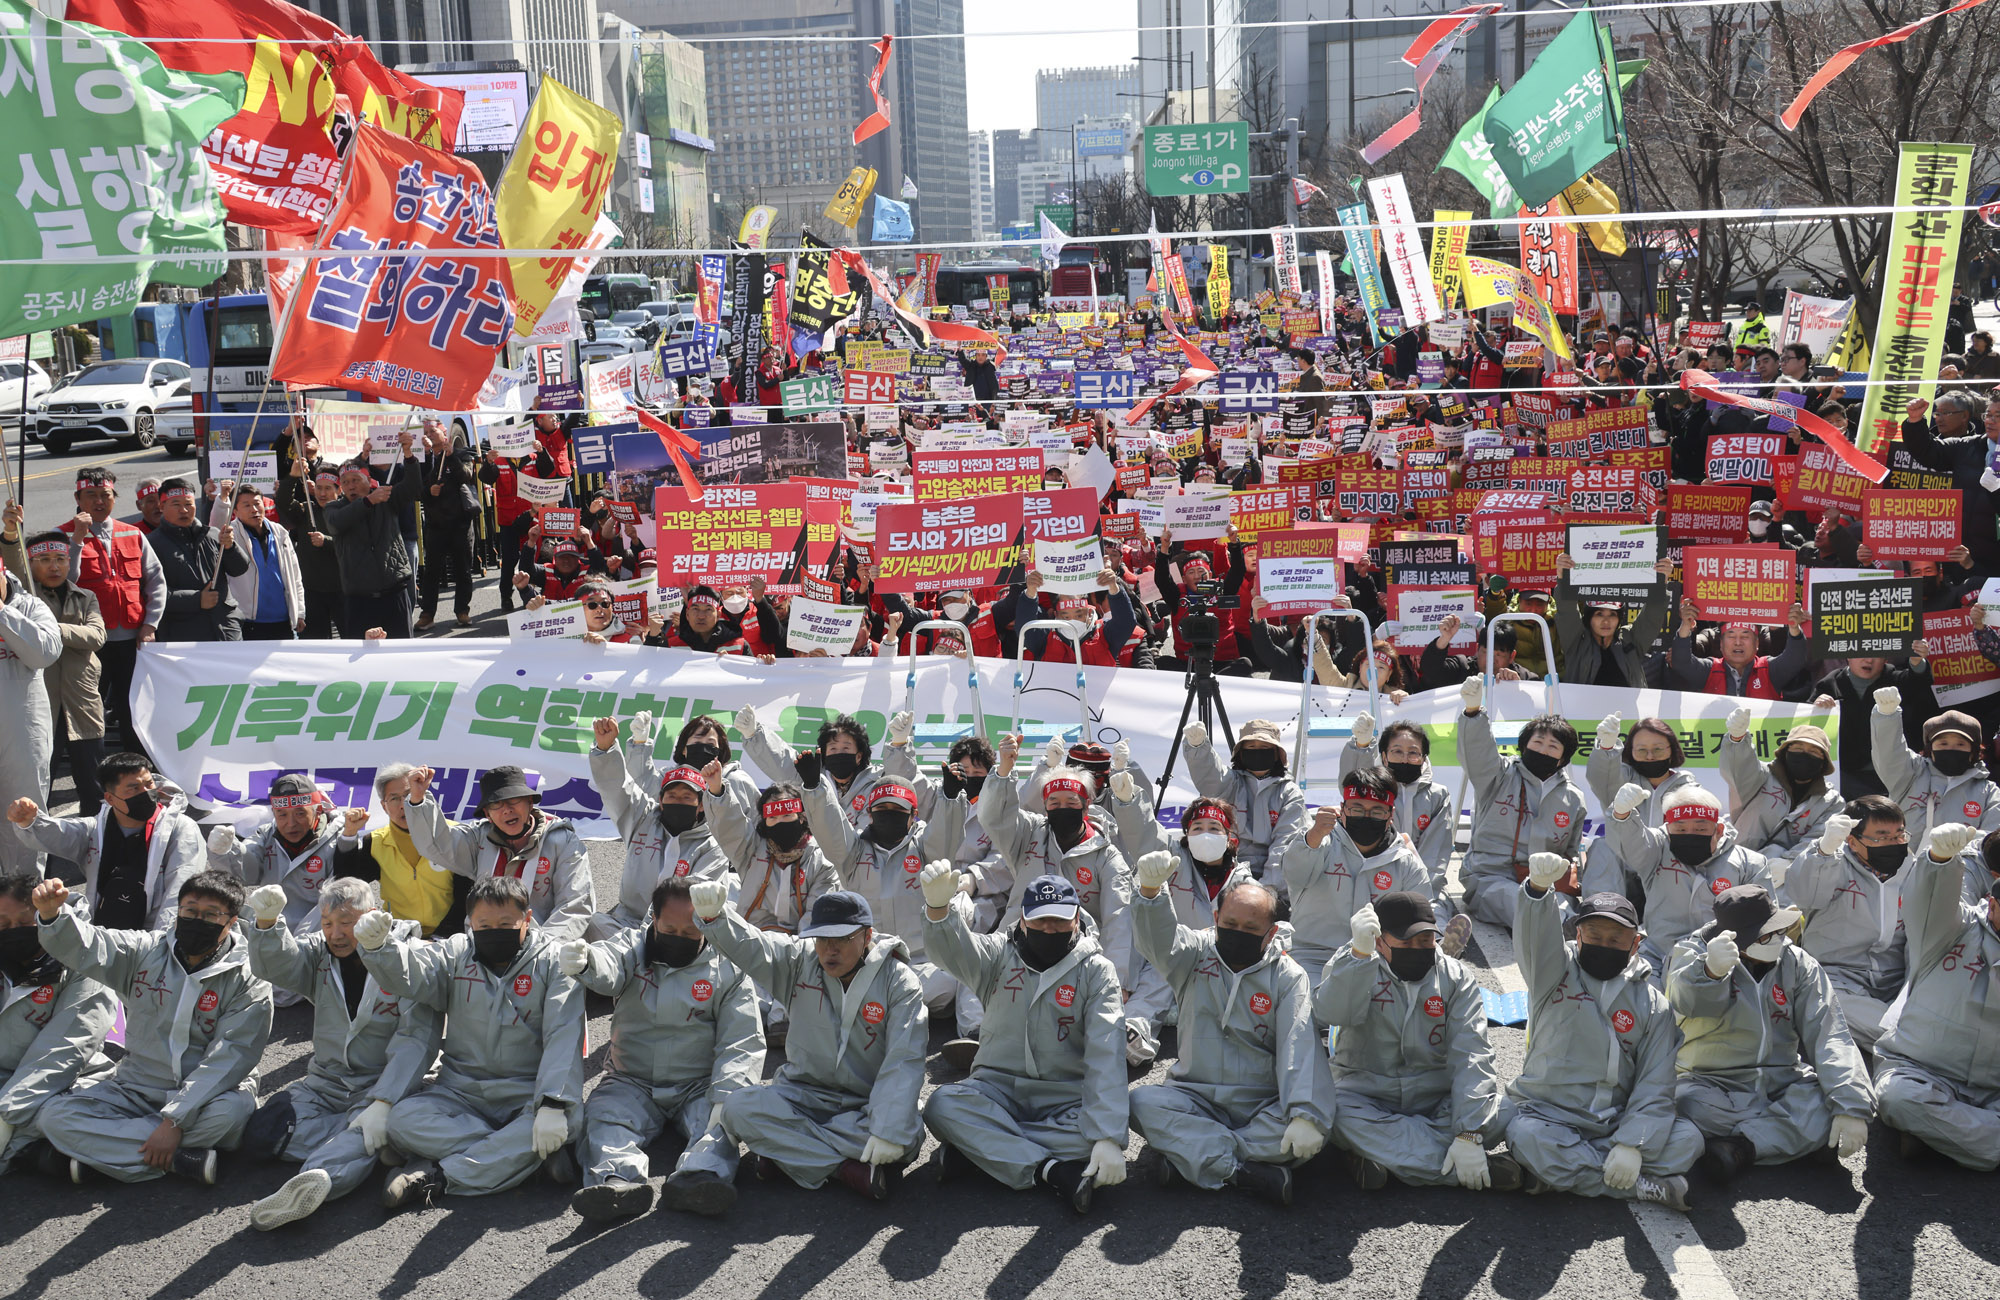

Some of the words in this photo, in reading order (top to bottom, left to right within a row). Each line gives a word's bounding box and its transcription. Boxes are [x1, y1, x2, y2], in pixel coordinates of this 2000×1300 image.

[1153, 129, 1238, 154] 종로1가
[527, 120, 615, 222] 입지
[1152, 156, 1186, 170] Jongno
[1188, 154, 1219, 168] 1(il)-ga
[1200, 172, 1208, 184] 6
[1896, 244, 1947, 329] 파괴하는
[20, 288, 87, 322] 공주시
[1507, 343, 1539, 354] 주민무시
[664, 344, 708, 374] 금산
[785, 379, 831, 411] 금산
[848, 372, 893, 402] 금산
[1079, 375, 1131, 404] 금산
[1223, 376, 1276, 407] 금산
[1374, 400, 1407, 412] 주민무시
[1513, 392, 1552, 412] 송전탑이
[1587, 413, 1615, 429] 송전선로
[1617, 407, 1646, 426] 공주통과
[1155, 432, 1196, 444] 주민없는
[1547, 422, 1574, 439] 송전선로
[1589, 427, 1647, 451] 결사반대
[1473, 448, 1515, 460] 공무원은
[1711, 436, 1781, 457] 송전탑이
[704, 450, 764, 478] 대한민국
[918, 459, 960, 475] 주민들의
[962, 458, 993, 473] 안전과
[995, 457, 1017, 471] 건강
[1019, 456, 1040, 470] 위협
[1407, 452, 1446, 465] 주민무시
[1511, 459, 1543, 476] 송전선로
[1611, 450, 1665, 468] 무조건
[1803, 451, 1835, 474] 세종시
[1283, 465, 1337, 481] 무조건
[1340, 473, 1398, 490] 무조건
[1570, 469, 1636, 488] 송전선로
[1798, 469, 1829, 495] 결사
[918, 477, 1008, 500] 고압송전선로
[1011, 474, 1042, 493] 건설
[703, 488, 757, 508] 한전은
[1229, 492, 1290, 515] 송전선로
[1338, 491, 1400, 515] 백지화
[1483, 492, 1545, 510] 송전선로
[1570, 490, 1636, 513] 완전무효
[1672, 494, 1682, 510] 왜
[1684, 495, 1747, 512] 우리지역인가?
[544, 512, 575, 521] 송전철탑
[921, 505, 976, 528] 농촌은
[1185, 513, 1212, 521] 분산하고
[1196, 505, 1222, 513] 전력수요
[1870, 499, 1881, 517] 왜
[1884, 498, 1958, 518] 우리지역인가?
[544, 520, 575, 531] 건설반대
[662, 507, 803, 531] 고압송전선로·철탑
[1031, 515, 1086, 538] 기업의
[1670, 513, 1692, 529] 정당한
[1692, 514, 1721, 531] 절차부터
[1722, 515, 1744, 531] 지켜라
[888, 531, 947, 552] 도시와
[951, 522, 1008, 548] 기업의
[1869, 521, 1893, 539] 정당한
[1896, 521, 1926, 539] 절차부터
[1929, 521, 1956, 540] 지켜라
[691, 530, 773, 552] 건설계획을
[1262, 540, 1272, 557] 왜
[1274, 538, 1334, 558] 우리지역인가?
[1502, 532, 1533, 550] 세종시
[1582, 541, 1607, 550] 수도권
[1610, 540, 1645, 549] 전력수요
[1043, 554, 1065, 564] 수도권
[1067, 551, 1096, 564] 전력수요
[1386, 548, 1413, 565] 세종시
[1415, 546, 1453, 564] 송전선로
[1596, 551, 1631, 560] 분산하고
[1878, 546, 1897, 555] 세종시
[1898, 547, 1917, 555] 장군면
[1918, 547, 1946, 556] 주민일동
[672, 553, 712, 574] 전면
[715, 551, 795, 572] 철회하라!
[879, 551, 968, 579] 전기식민지가
[970, 545, 1021, 571] 아니다!
[1055, 563, 1087, 574] 분산하고
[1502, 551, 1532, 572] 결사
[1696, 557, 1720, 578] 지역
[1723, 557, 1758, 579] 생존권
[1761, 558, 1790, 580] 위협!
[698, 574, 724, 585] 영암군
[1270, 568, 1293, 576] 수도권
[1295, 568, 1324, 576] 전력수요
[1399, 570, 1428, 584] 세종시
[1430, 570, 1470, 585] 송전선로
[915, 580, 941, 591] 영암군
[942, 576, 985, 589] 대책위원회
[1578, 586, 1599, 595] 세종시
[1600, 587, 1620, 595] 장군면
[1621, 588, 1649, 597] 주민일동
[1696, 582, 1739, 603] 송전선로
[1740, 582, 1789, 603] 반대한다!
[1270, 602, 1288, 611] 세종시
[1820, 591, 1843, 610] 안전
[1844, 590, 1867, 609] 없는
[1868, 587, 1914, 609] 송전선로
[1409, 604, 1431, 613] 수도권
[1434, 603, 1464, 613] 전력수요
[1705, 606, 1727, 616] 세종시
[1727, 607, 1750, 617] 장군면
[1750, 608, 1779, 618] 주민일동
[519, 619, 543, 632] 수도권
[544, 614, 576, 628] 전력수요
[800, 612, 822, 624] 수도권
[823, 616, 853, 628] 전력수요
[1820, 615, 1858, 636] 주민이
[1862, 611, 1914, 634] 막아낸다
[534, 626, 565, 639] 분산하고
[809, 624, 841, 636] 분산하고
[1827, 639, 1859, 653] 세종시
[1861, 637, 1903, 652] 주민일동
[177, 680, 460, 752] 기후위기
[668, 768, 706, 784] 결사반대
[869, 784, 906, 802] 결사반대
[1045, 779, 1084, 794] 결사반대
[765, 799, 802, 815] 결사반대
[1672, 805, 1717, 820] 결사반대
